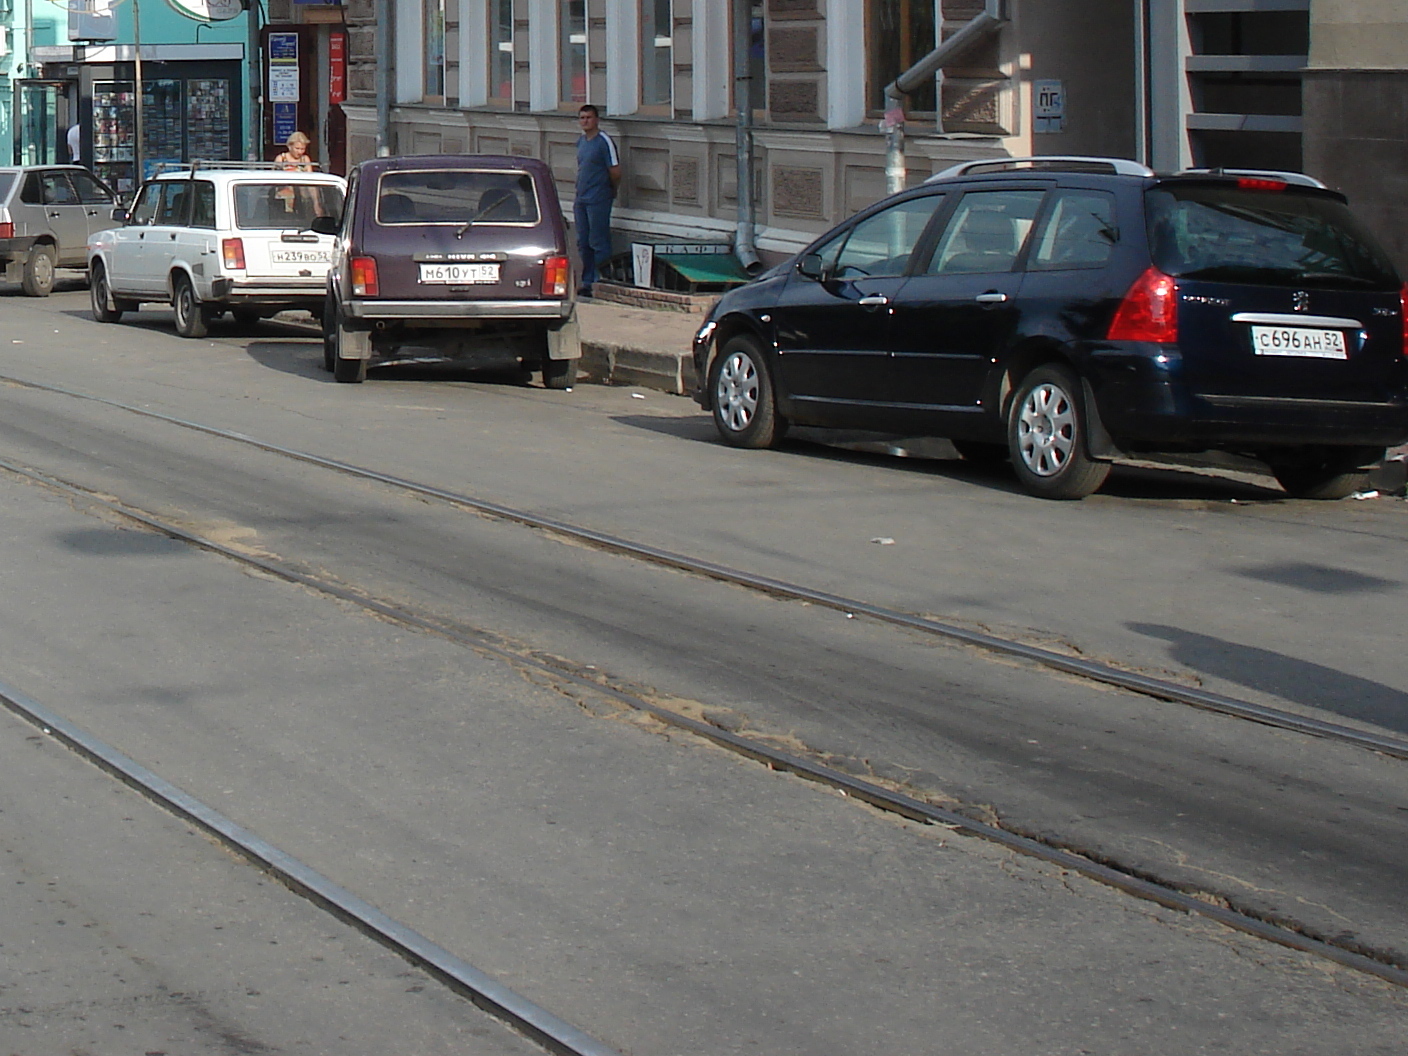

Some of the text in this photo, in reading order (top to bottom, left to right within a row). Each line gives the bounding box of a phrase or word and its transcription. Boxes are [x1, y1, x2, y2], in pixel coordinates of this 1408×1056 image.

[425, 265, 494, 279] М610УТ 52
[1260, 329, 1339, 350] С696АН 52
